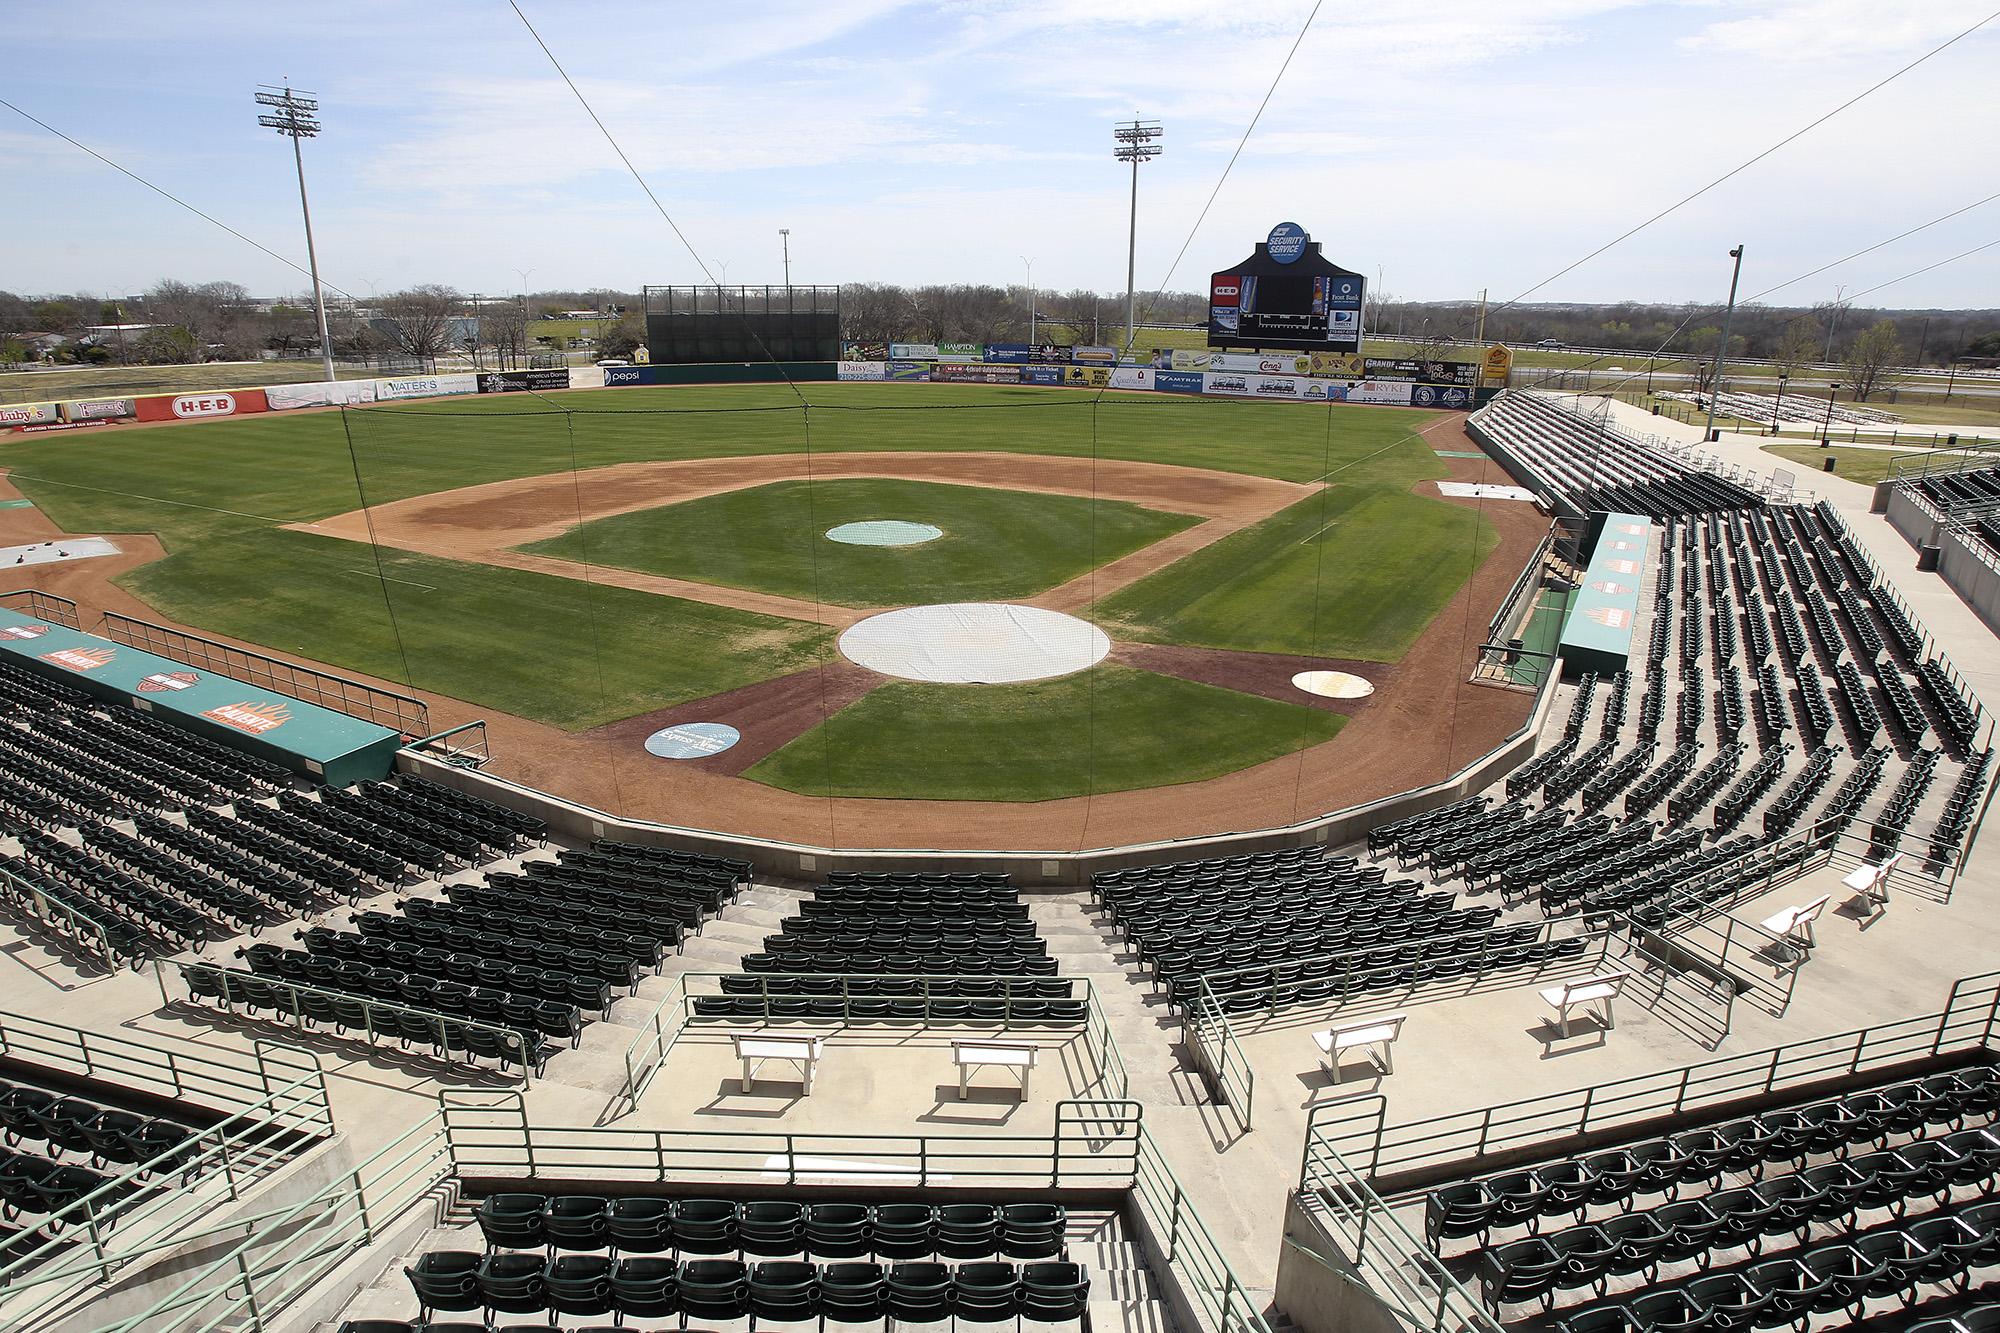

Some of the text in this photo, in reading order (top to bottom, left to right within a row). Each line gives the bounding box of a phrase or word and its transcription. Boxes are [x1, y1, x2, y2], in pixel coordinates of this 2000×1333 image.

[1270, 236, 1304, 245] SECURITY
[1270, 245, 1299, 253] SERVICE
[944, 343, 976, 352] HAMPTON
[844, 363, 867, 374] Daisy
[1260, 361, 1281, 370] Conn's
[612, 371, 640, 381] pepsi
[389, 380, 438, 391] WATER'S
[1376, 383, 1405, 392] RYKE
[211, 706, 278, 731] CALIENTE
